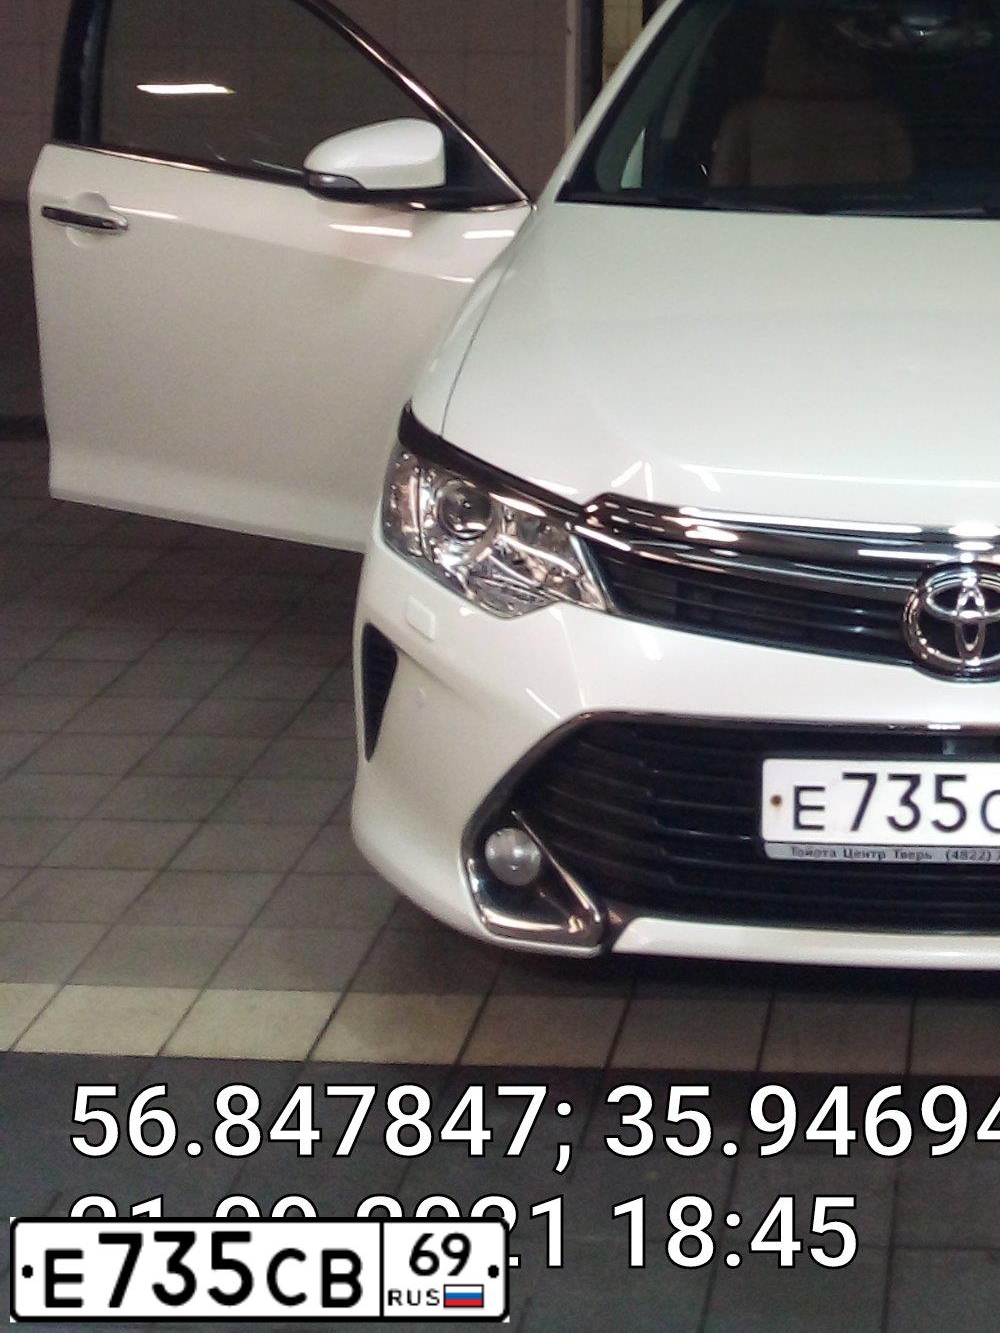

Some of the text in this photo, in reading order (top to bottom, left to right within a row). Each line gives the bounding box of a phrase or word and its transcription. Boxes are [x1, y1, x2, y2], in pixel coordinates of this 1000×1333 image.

[843, 847, 886, 861] Центр
[894, 848, 932, 861] Тверь
[944, 849, 992, 862] (4822)
